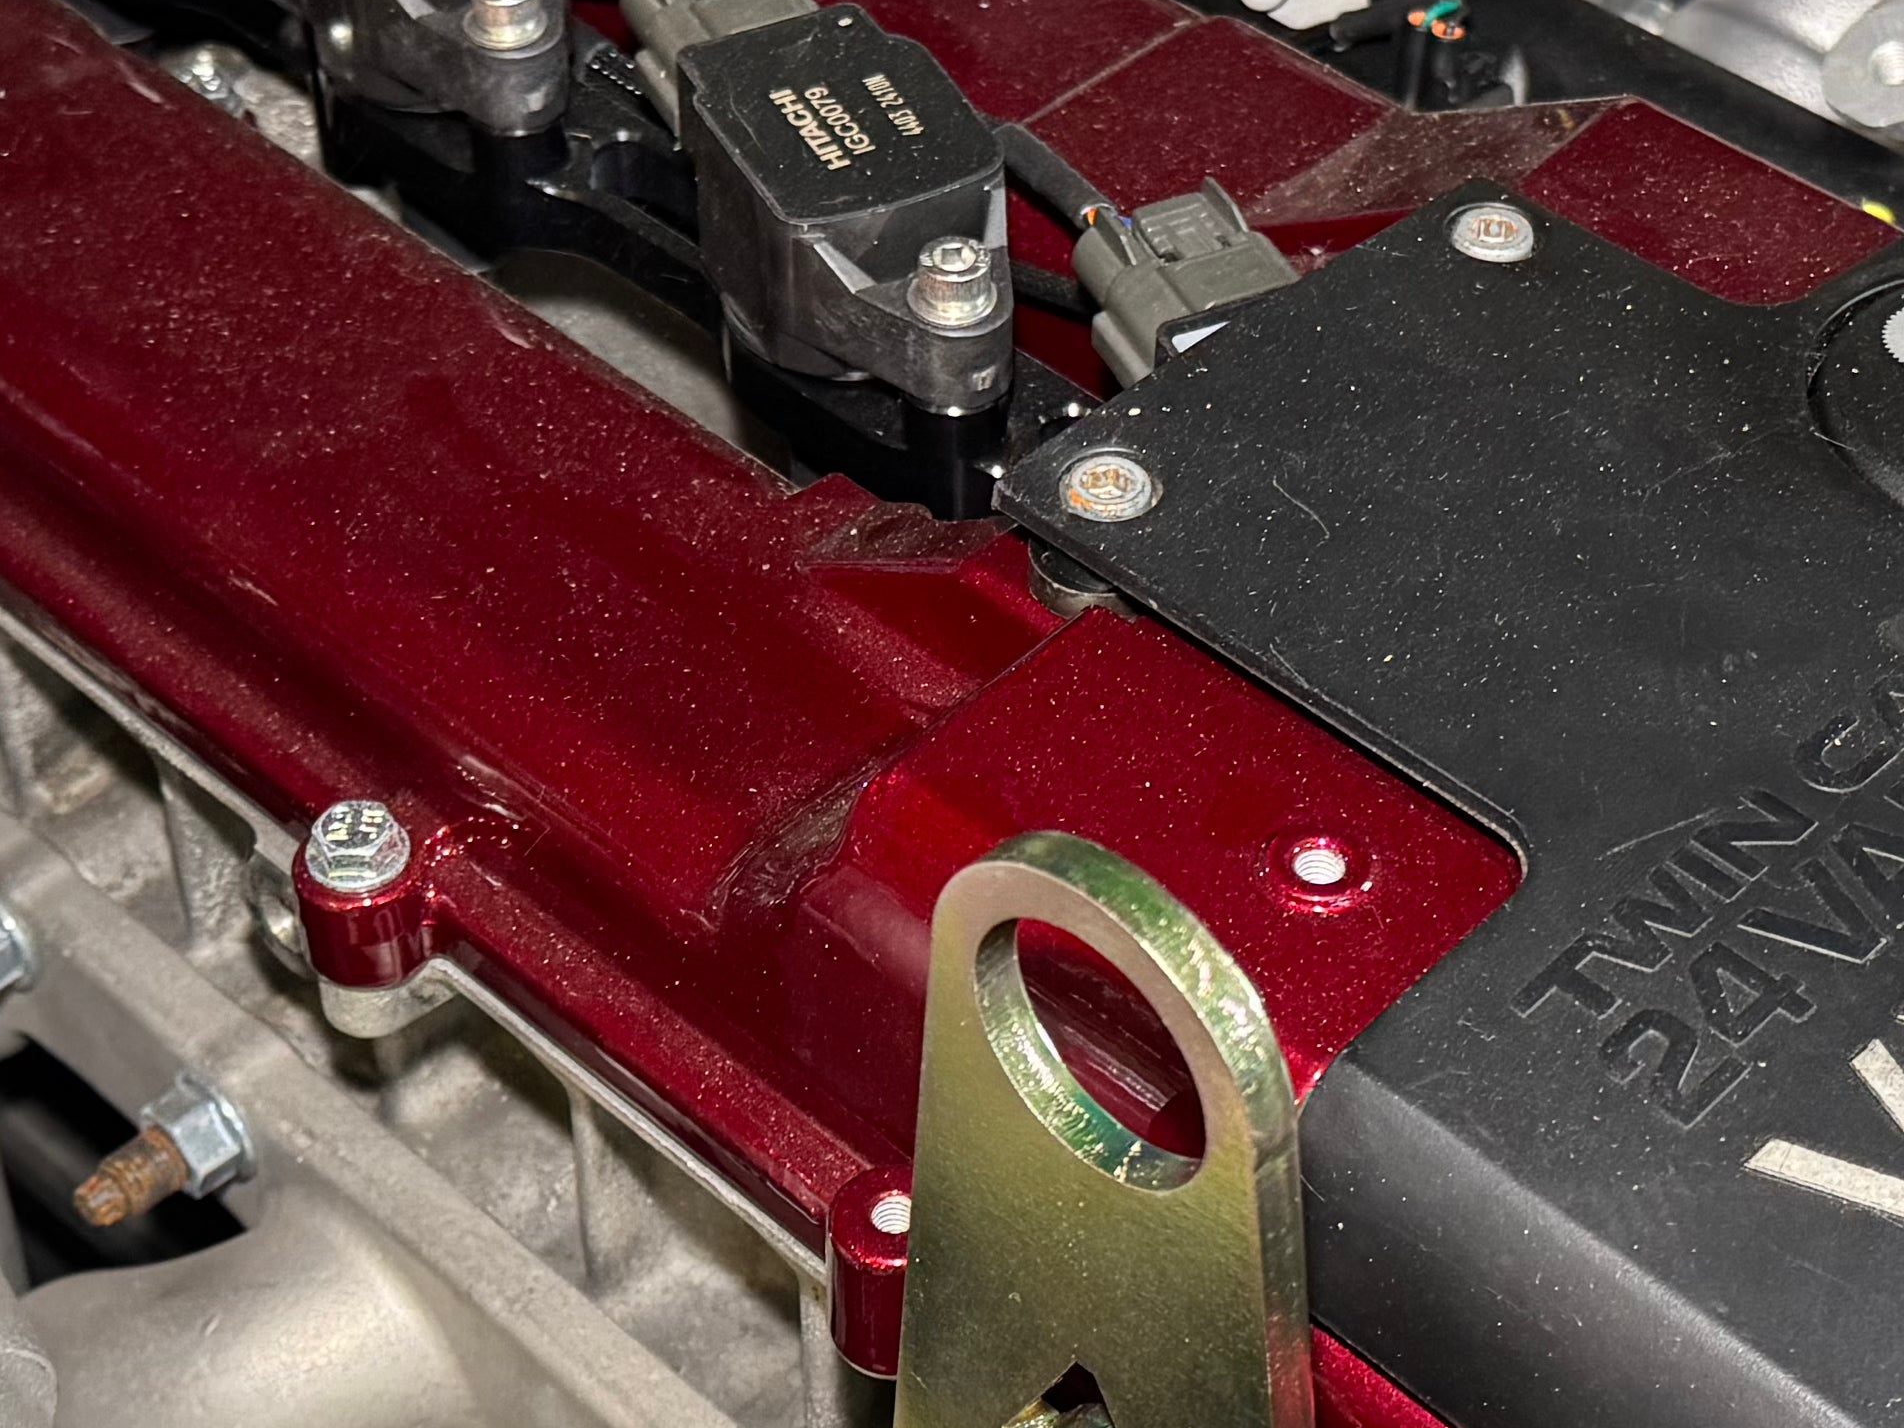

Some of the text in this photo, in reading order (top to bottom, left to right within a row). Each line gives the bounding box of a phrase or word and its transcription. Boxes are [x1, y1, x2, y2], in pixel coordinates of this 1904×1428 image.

[768, 88, 852, 170] HITACHI
[804, 86, 877, 155] IGC0079
[861, 74, 925, 136] 4403 2410N
[1511, 787, 1818, 1021] TWIN
